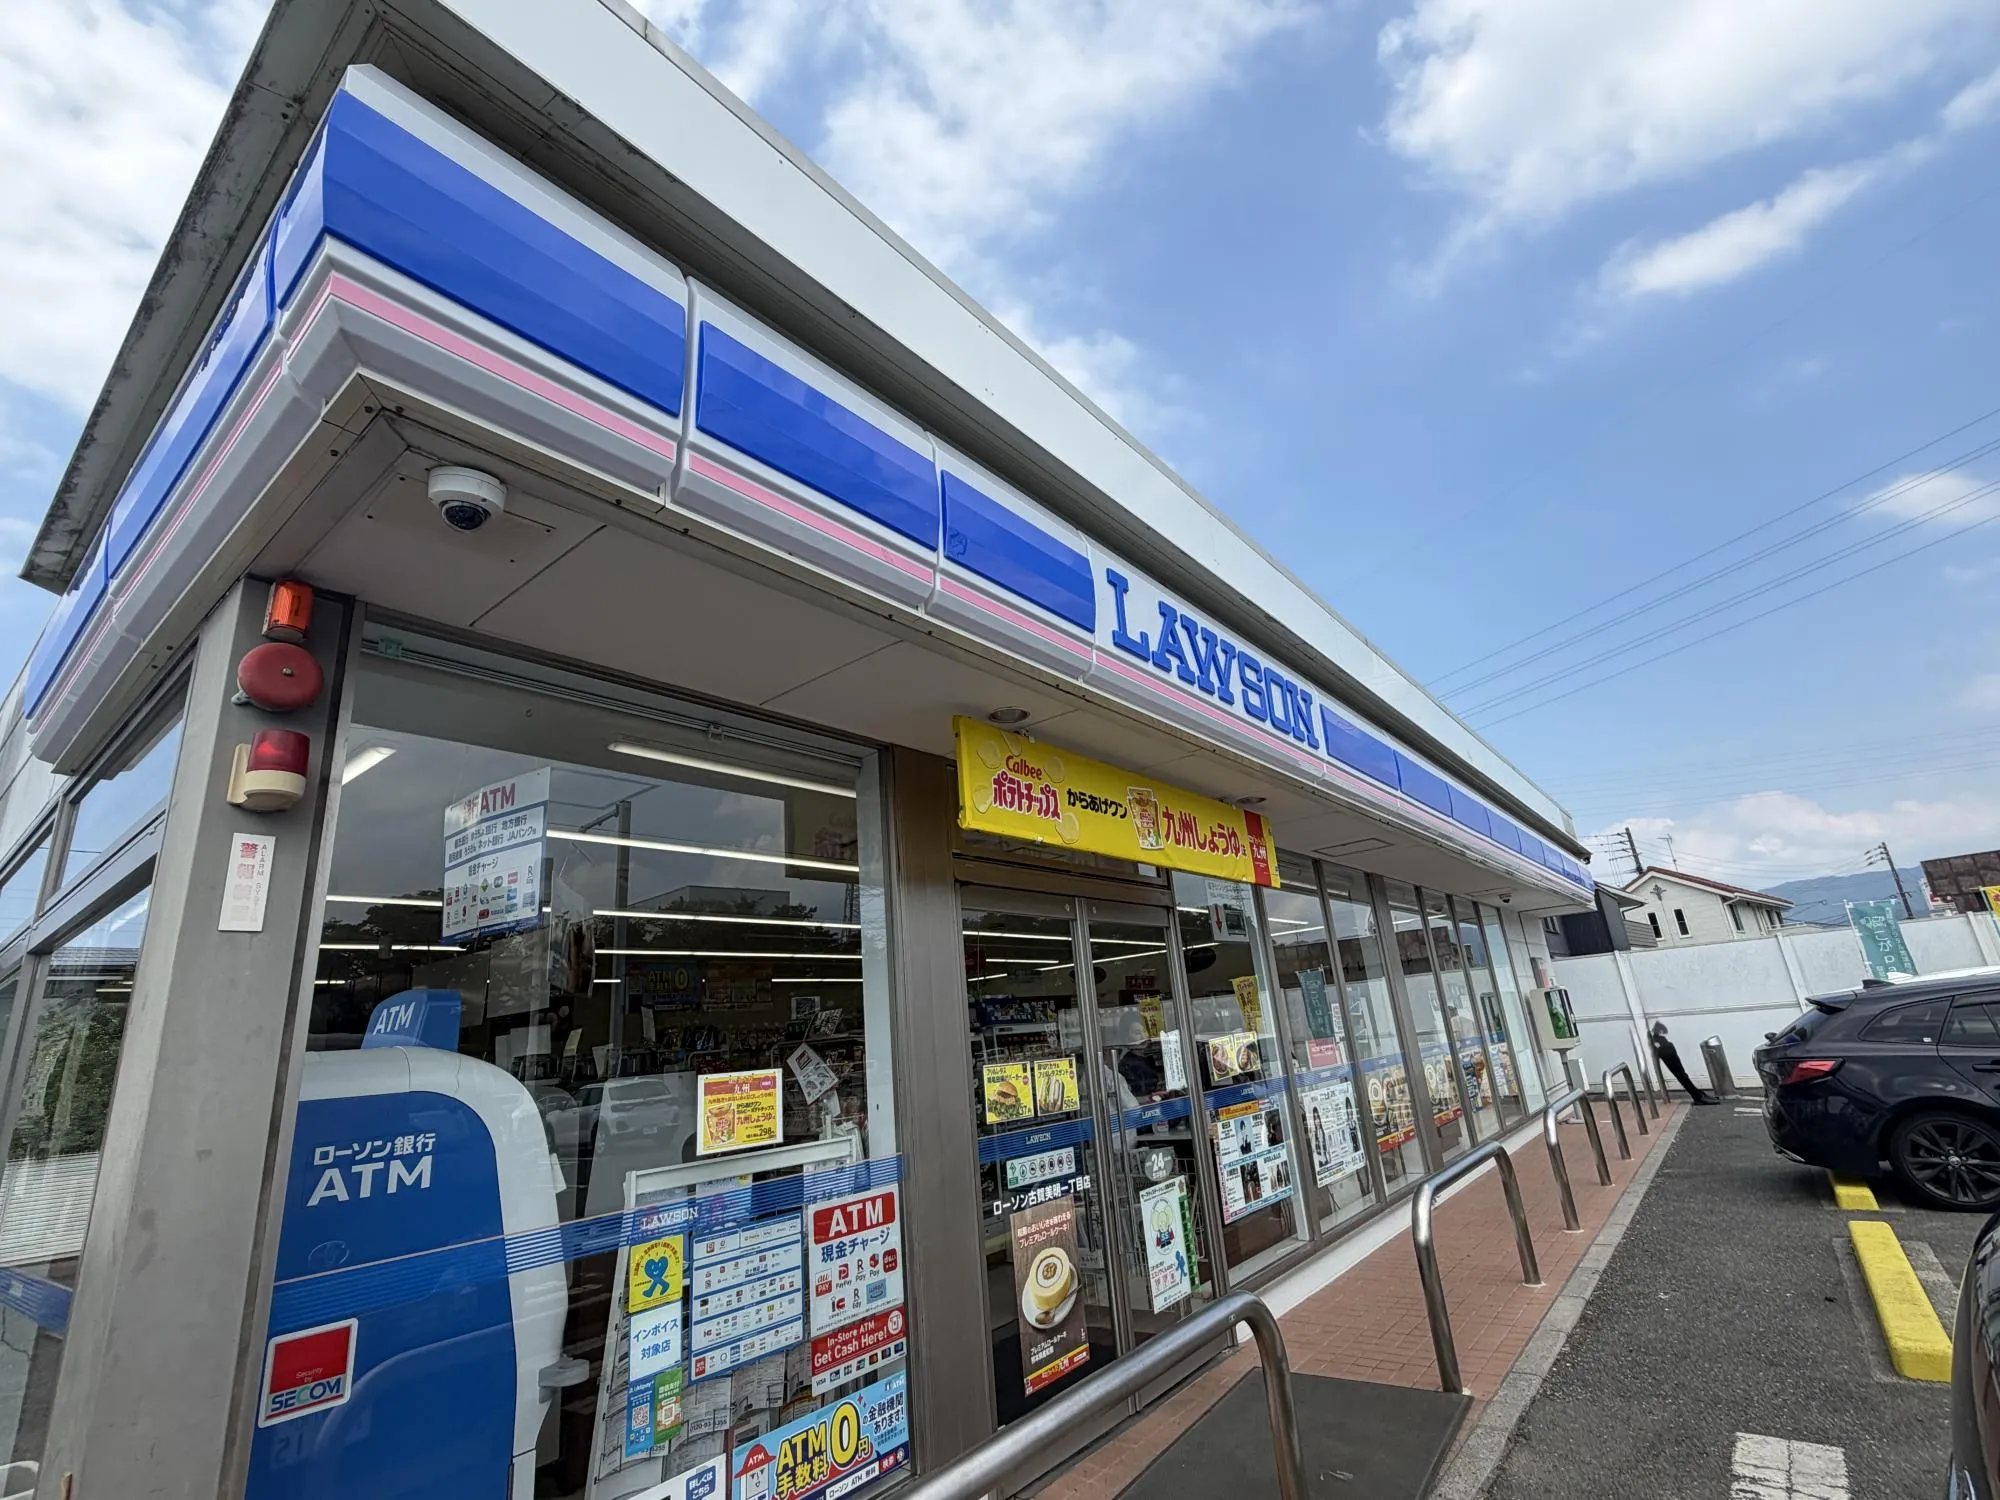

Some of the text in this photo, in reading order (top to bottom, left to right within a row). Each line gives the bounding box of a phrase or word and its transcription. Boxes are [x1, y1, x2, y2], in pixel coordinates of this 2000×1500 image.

[1106, 567, 1319, 750] LAWSON
[1006, 754, 1042, 781] Calbee
[993, 769, 1061, 821] ポテトチップス
[1066, 787, 1128, 819] からあげクン
[501, 814, 528, 831] 地方銀行
[478, 834, 504, 852] ネット銀行
[373, 1002, 415, 1035] ATM
[313, 1133, 437, 1166] ローソン銀行
[1025, 1132, 1052, 1145] LAWSON
[1151, 1152, 1165, 1172] 24
[306, 1155, 433, 1207] ATM
[993, 1175, 1091, 1216] ローソン古賀美明一丁目店
[641, 1206, 699, 1230] LAWSON
[828, 1198, 883, 1238] ATM
[820, 1228, 891, 1264] 現金チャージ
[857, 1259, 864, 1271] R
[869, 1269, 880, 1277] Pay
[817, 1272, 829, 1283] au
[817, 1281, 829, 1293] PAY
[835, 1280, 852, 1289] PayPay
[853, 1288, 860, 1300] R
[632, 1317, 679, 1344] インボイス
[827, 1327, 858, 1348] In-Store
[859, 1320, 875, 1333] ATM
[640, 1339, 671, 1360] 対象店
[814, 1326, 888, 1368] Get Cash Here!
[296, 1367, 324, 1379] Security
[815, 1377, 826, 1386] VISA
[271, 1377, 342, 1412] SECOM
[862, 1391, 904, 1425] の金融機関
[873, 1406, 905, 1437] あります!
[747, 1452, 765, 1467] ATM
[776, 1420, 827, 1476] ATM
[882, 1454, 896, 1470] 検索
[689, 1470, 713, 1490] 詳しくは
[775, 1450, 829, 1500] 手数料
[828, 1482, 849, 1499] ローソン
[850, 1475, 863, 1488] ATM
[692, 1484, 710, 1499] こちら
